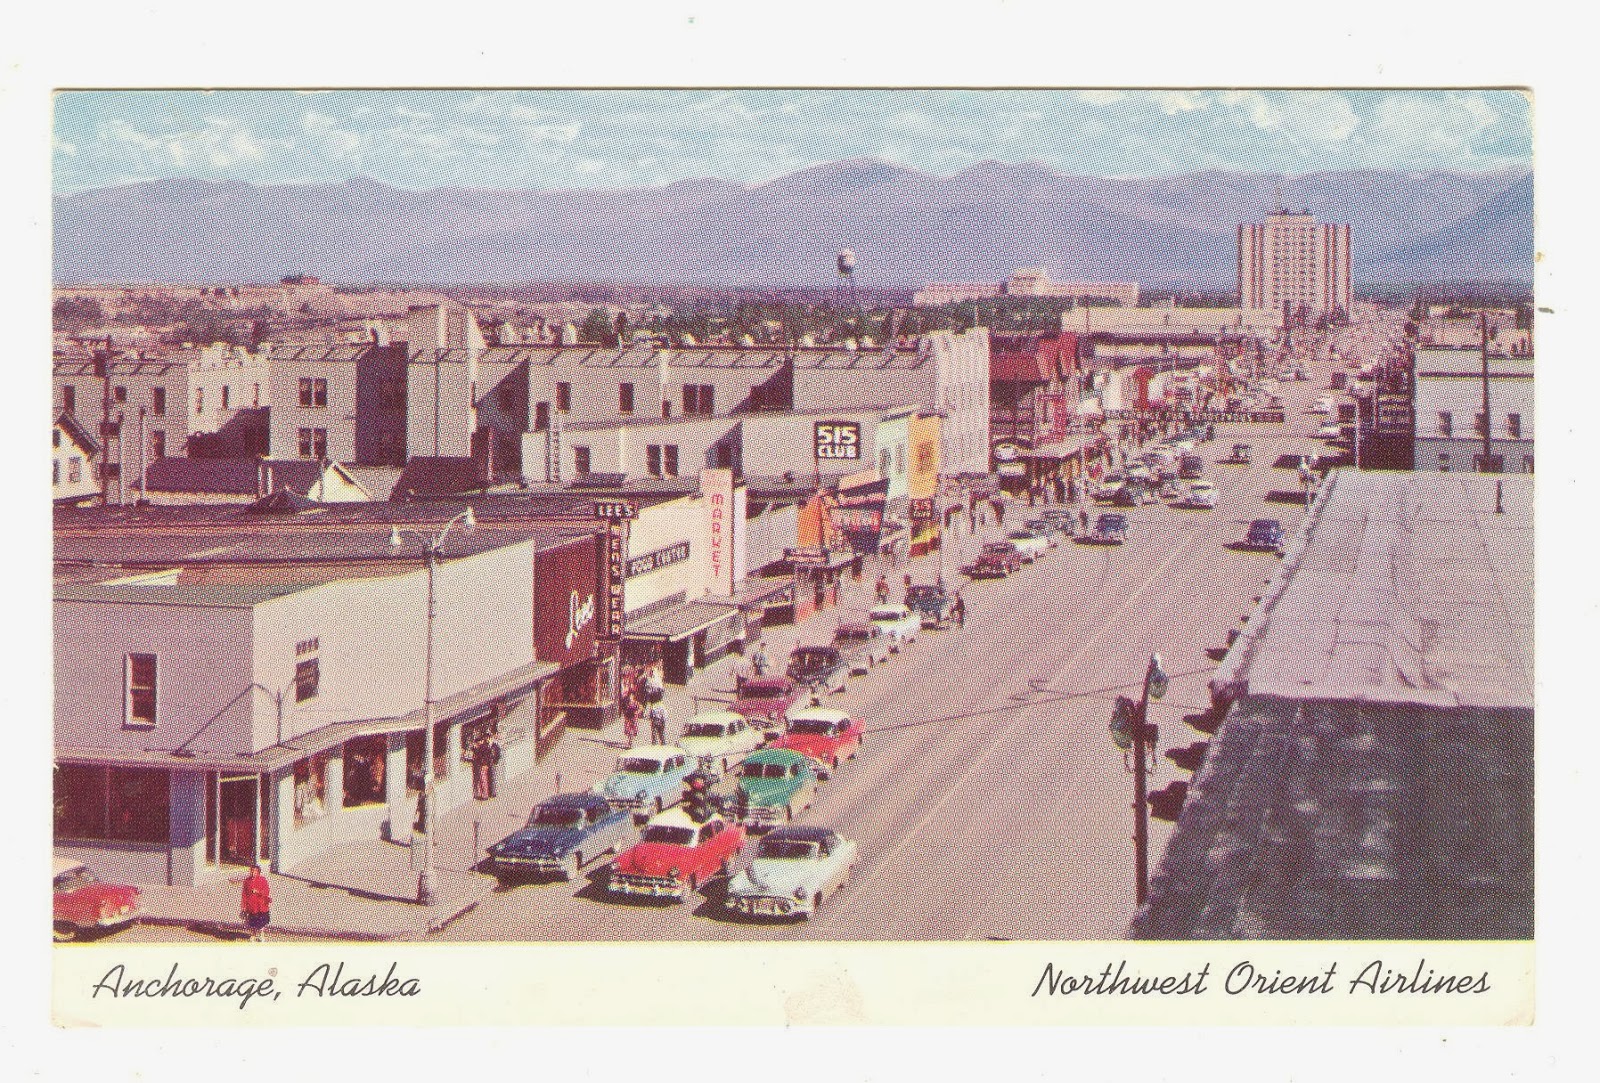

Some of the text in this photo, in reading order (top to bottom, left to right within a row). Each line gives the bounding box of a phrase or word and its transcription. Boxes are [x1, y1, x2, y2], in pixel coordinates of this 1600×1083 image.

[817, 425, 858, 445] 515
[817, 444, 857, 458] CLUB
[710, 493, 725, 577] MARKET
[631, 554, 654, 575] FOOD
[611, 583, 621, 635] WEAR
